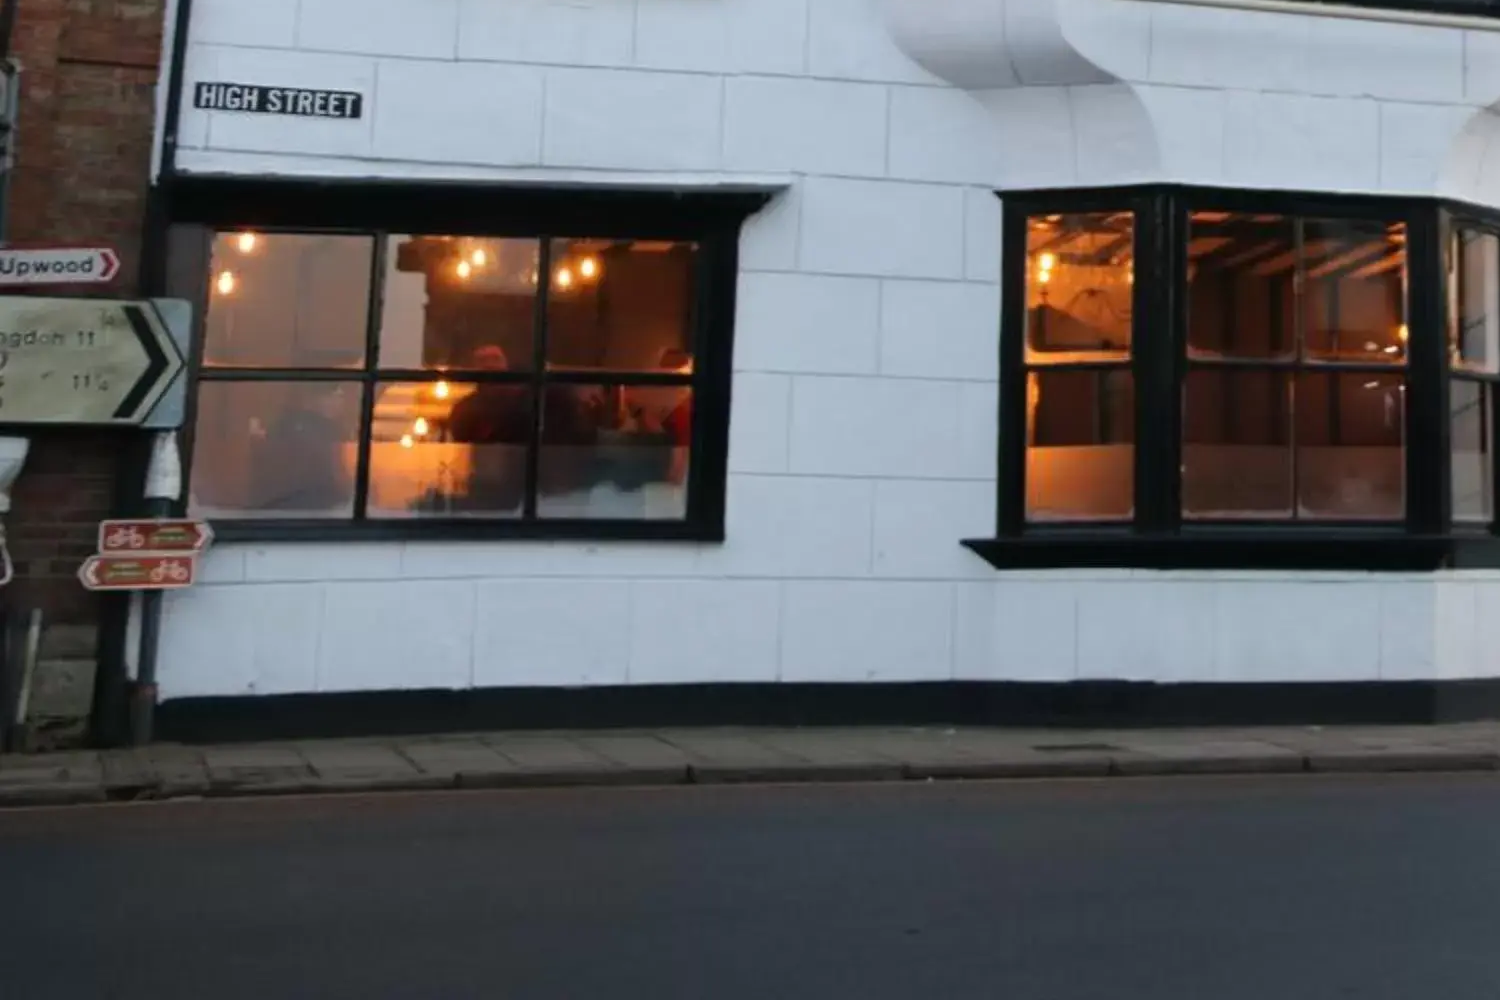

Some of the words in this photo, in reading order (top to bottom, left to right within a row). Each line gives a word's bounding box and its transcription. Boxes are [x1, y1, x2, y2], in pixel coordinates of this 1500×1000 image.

[200, 84, 259, 111] HIGH
[265, 89, 357, 117] STREET
[0, 256, 95, 277] Upwood
